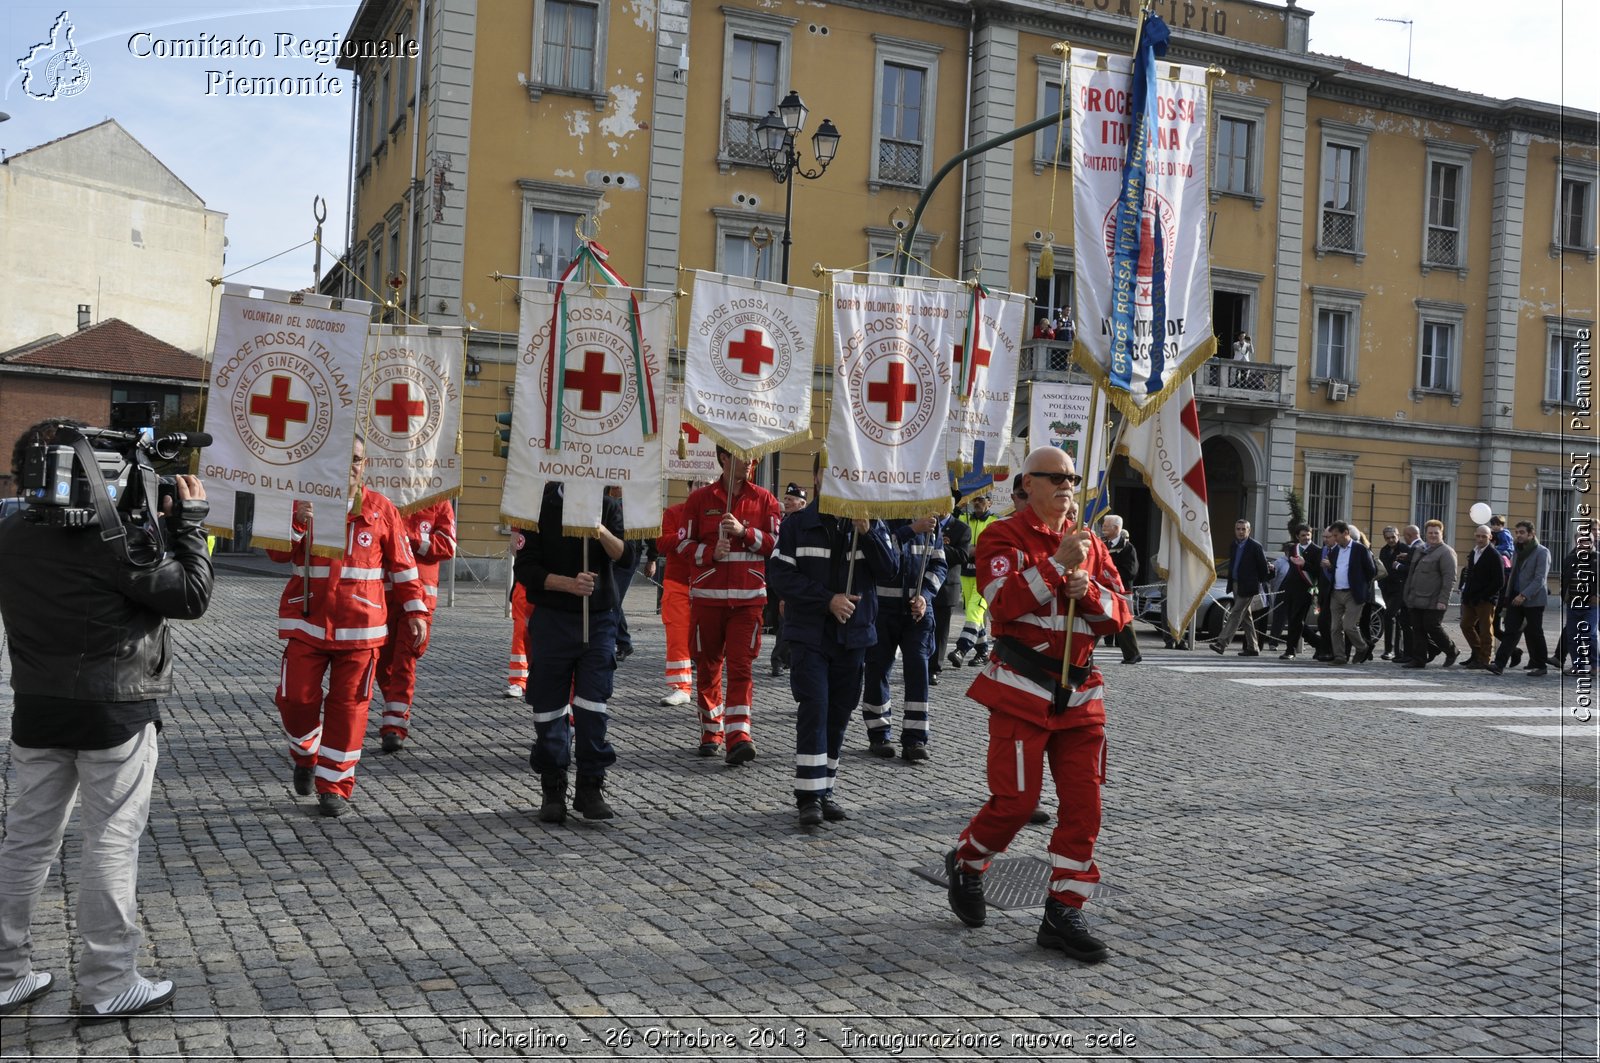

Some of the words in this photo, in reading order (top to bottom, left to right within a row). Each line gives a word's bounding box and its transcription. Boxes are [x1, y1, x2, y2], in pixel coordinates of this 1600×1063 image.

[1157, 96, 1194, 124] OSSA
[1120, 178, 1140, 250] ITALIANA
[1116, 260, 1132, 313] ROSSA
[242, 309, 283, 324] VOLONTARI
[287, 317, 301, 328] DEL
[306, 318, 345, 333] SOCCORSO
[699, 304, 729, 336] CROCE
[731, 299, 769, 312] ROSSA
[772, 308, 804, 353] ITALIANA
[724, 320, 733, 331] DI
[735, 314, 771, 330] GINEVRA
[864, 317, 909, 336] ROSSA
[577, 332, 625, 354] GINEVRA
[772, 329, 784, 339] 22
[712, 329, 738, 385] CONVENZIONE
[865, 348, 876, 361] DI
[1114, 321, 1127, 374] CROCE
[252, 362, 263, 375] DI
[268, 356, 315, 380] GINEVRA
[624, 355, 636, 368] 22
[777, 342, 789, 377] AGOSTO
[216, 341, 253, 388] CROCE
[254, 332, 305, 349] ROSSA
[308, 340, 353, 409] ITALIANA
[918, 364, 930, 378] 22
[313, 382, 327, 398] 22
[973, 388, 1009, 401] LOCALE
[697, 390, 784, 413] SOTTOCOMITATO
[789, 405, 798, 413] DI
[919, 381, 933, 422] AGOSTO
[234, 375, 265, 455] CONVENZIONE
[310, 401, 329, 447] AGOSTO
[599, 412, 624, 430] 1864
[697, 405, 795, 430] CARMAGNOLA
[948, 410, 990, 425] NTENA
[286, 441, 313, 461] 1864
[529, 437, 592, 453] COTATO
[597, 444, 645, 456] LOCALE
[408, 458, 455, 468] LOCALE
[581, 455, 593, 465] DI
[539, 462, 631, 480] MONCALIERI
[832, 466, 920, 484] CASTAGNOLE
[206, 465, 256, 486] GRUPPO
[261, 475, 272, 488] DI
[277, 478, 294, 491] LA
[298, 481, 342, 499] LOGGIA
[364, 476, 442, 488] ARIGNANO
